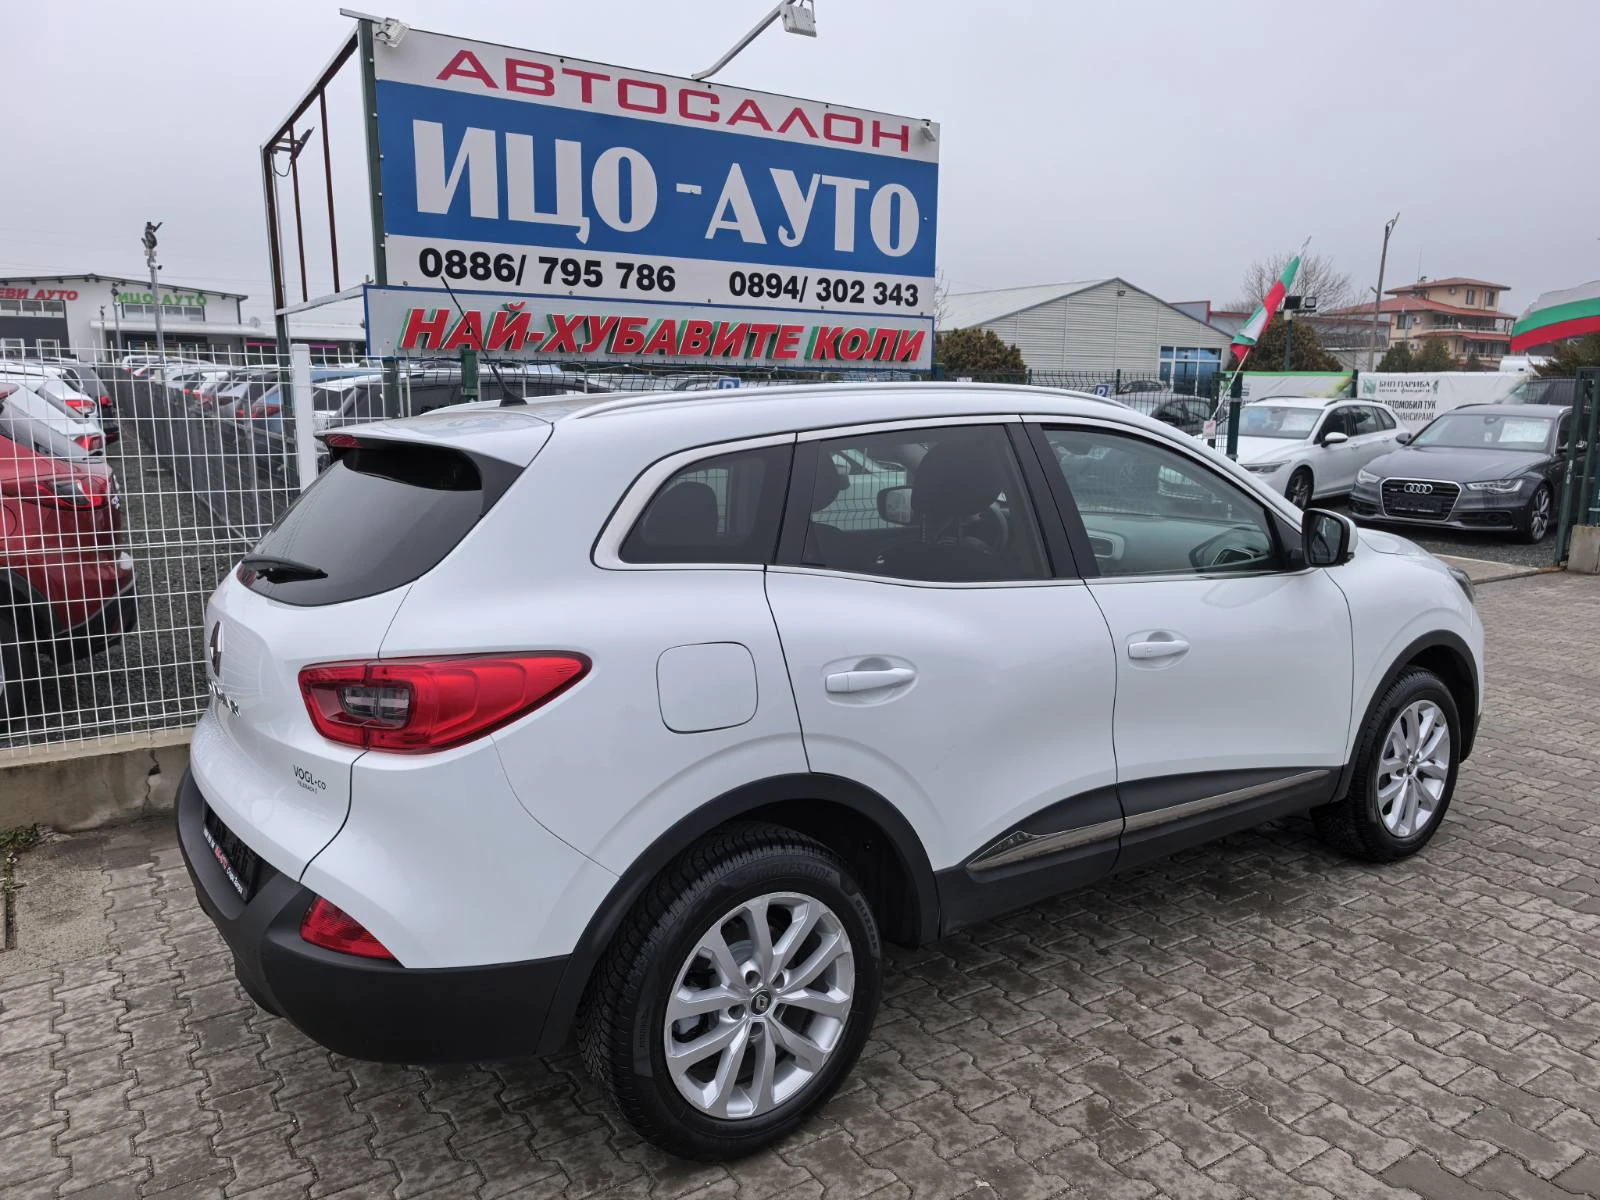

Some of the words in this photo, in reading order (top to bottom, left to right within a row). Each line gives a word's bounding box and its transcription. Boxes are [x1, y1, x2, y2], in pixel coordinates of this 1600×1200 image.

[436, 49, 910, 153] АВТОСАЛОН
[34, 288, 78, 301] АУТО
[418, 247, 527, 287] 0886/
[537, 256, 603, 289] 795
[615, 261, 676, 293] 786
[728, 270, 809, 303] 0894/
[815, 276, 865, 305] 302
[873, 281, 919, 308] 343
[162, 293, 207, 305] АУТО
[401, 302, 805, 359] НАЙ-ХУБАВИТЕ
[807, 325, 926, 361] КОЛИ
[1424, 400, 1437, 409] ТУК
